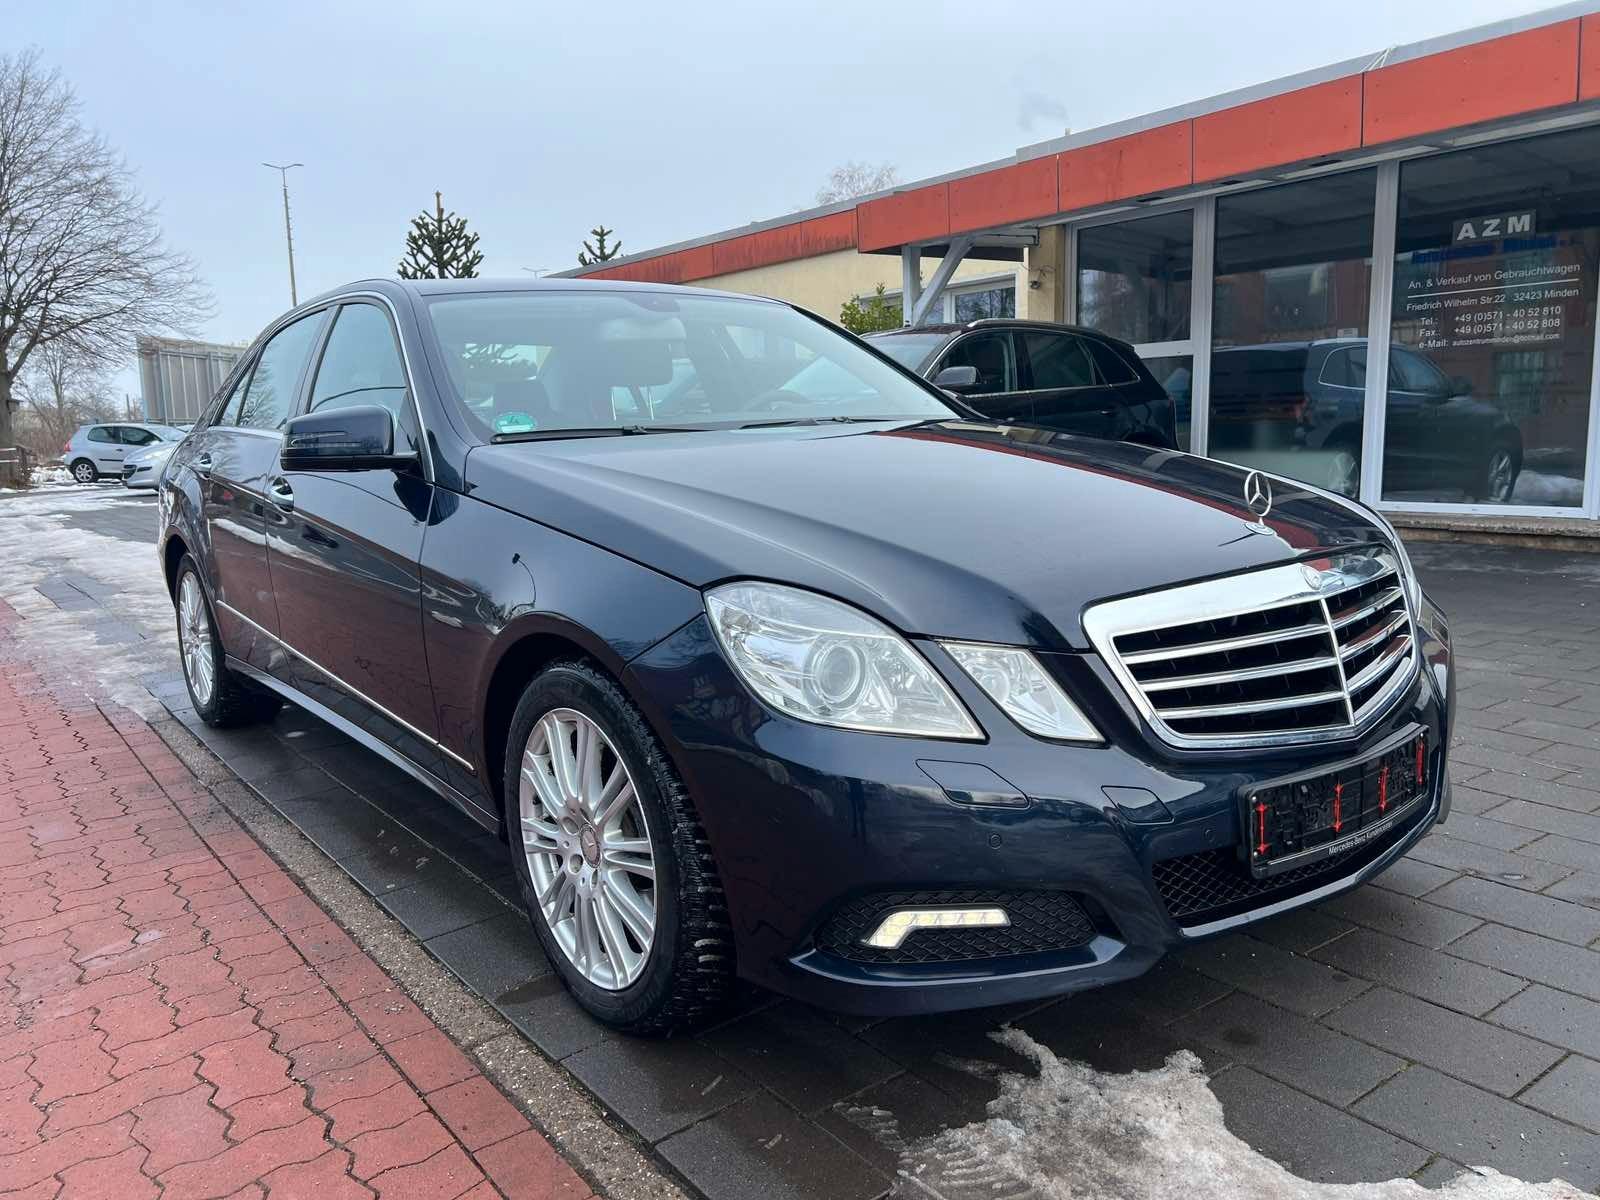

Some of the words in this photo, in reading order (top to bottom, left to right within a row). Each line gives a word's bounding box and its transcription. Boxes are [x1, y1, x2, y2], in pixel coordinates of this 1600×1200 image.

[1426, 278, 1433, 288] &
[1436, 273, 1472, 287] Verkauf
[1473, 274, 1491, 282] von
[1494, 263, 1581, 280] Gebrauchtwagen
[1406, 301, 1442, 312] Friedrich
[1444, 298, 1478, 308] Wilhelm
[1513, 290, 1542, 302] 32423
[1544, 288, 1579, 299] Minden
[1454, 313, 1472, 322] +49
[1473, 310, 1504, 323] (0)571
[1512, 308, 1526, 318] 40
[1527, 307, 1540, 317] 52
[1542, 305, 1561, 316] 810
[1454, 324, 1472, 334] +49
[1473, 322, 1503, 335] (0)571
[1512, 320, 1525, 330] 40
[1527, 319, 1540, 329] 52
[1541, 318, 1561, 328] 808
[1418, 339, 1449, 349] e-Mail:
[1328, 834, 1366, 856] Mercedes-Benz
